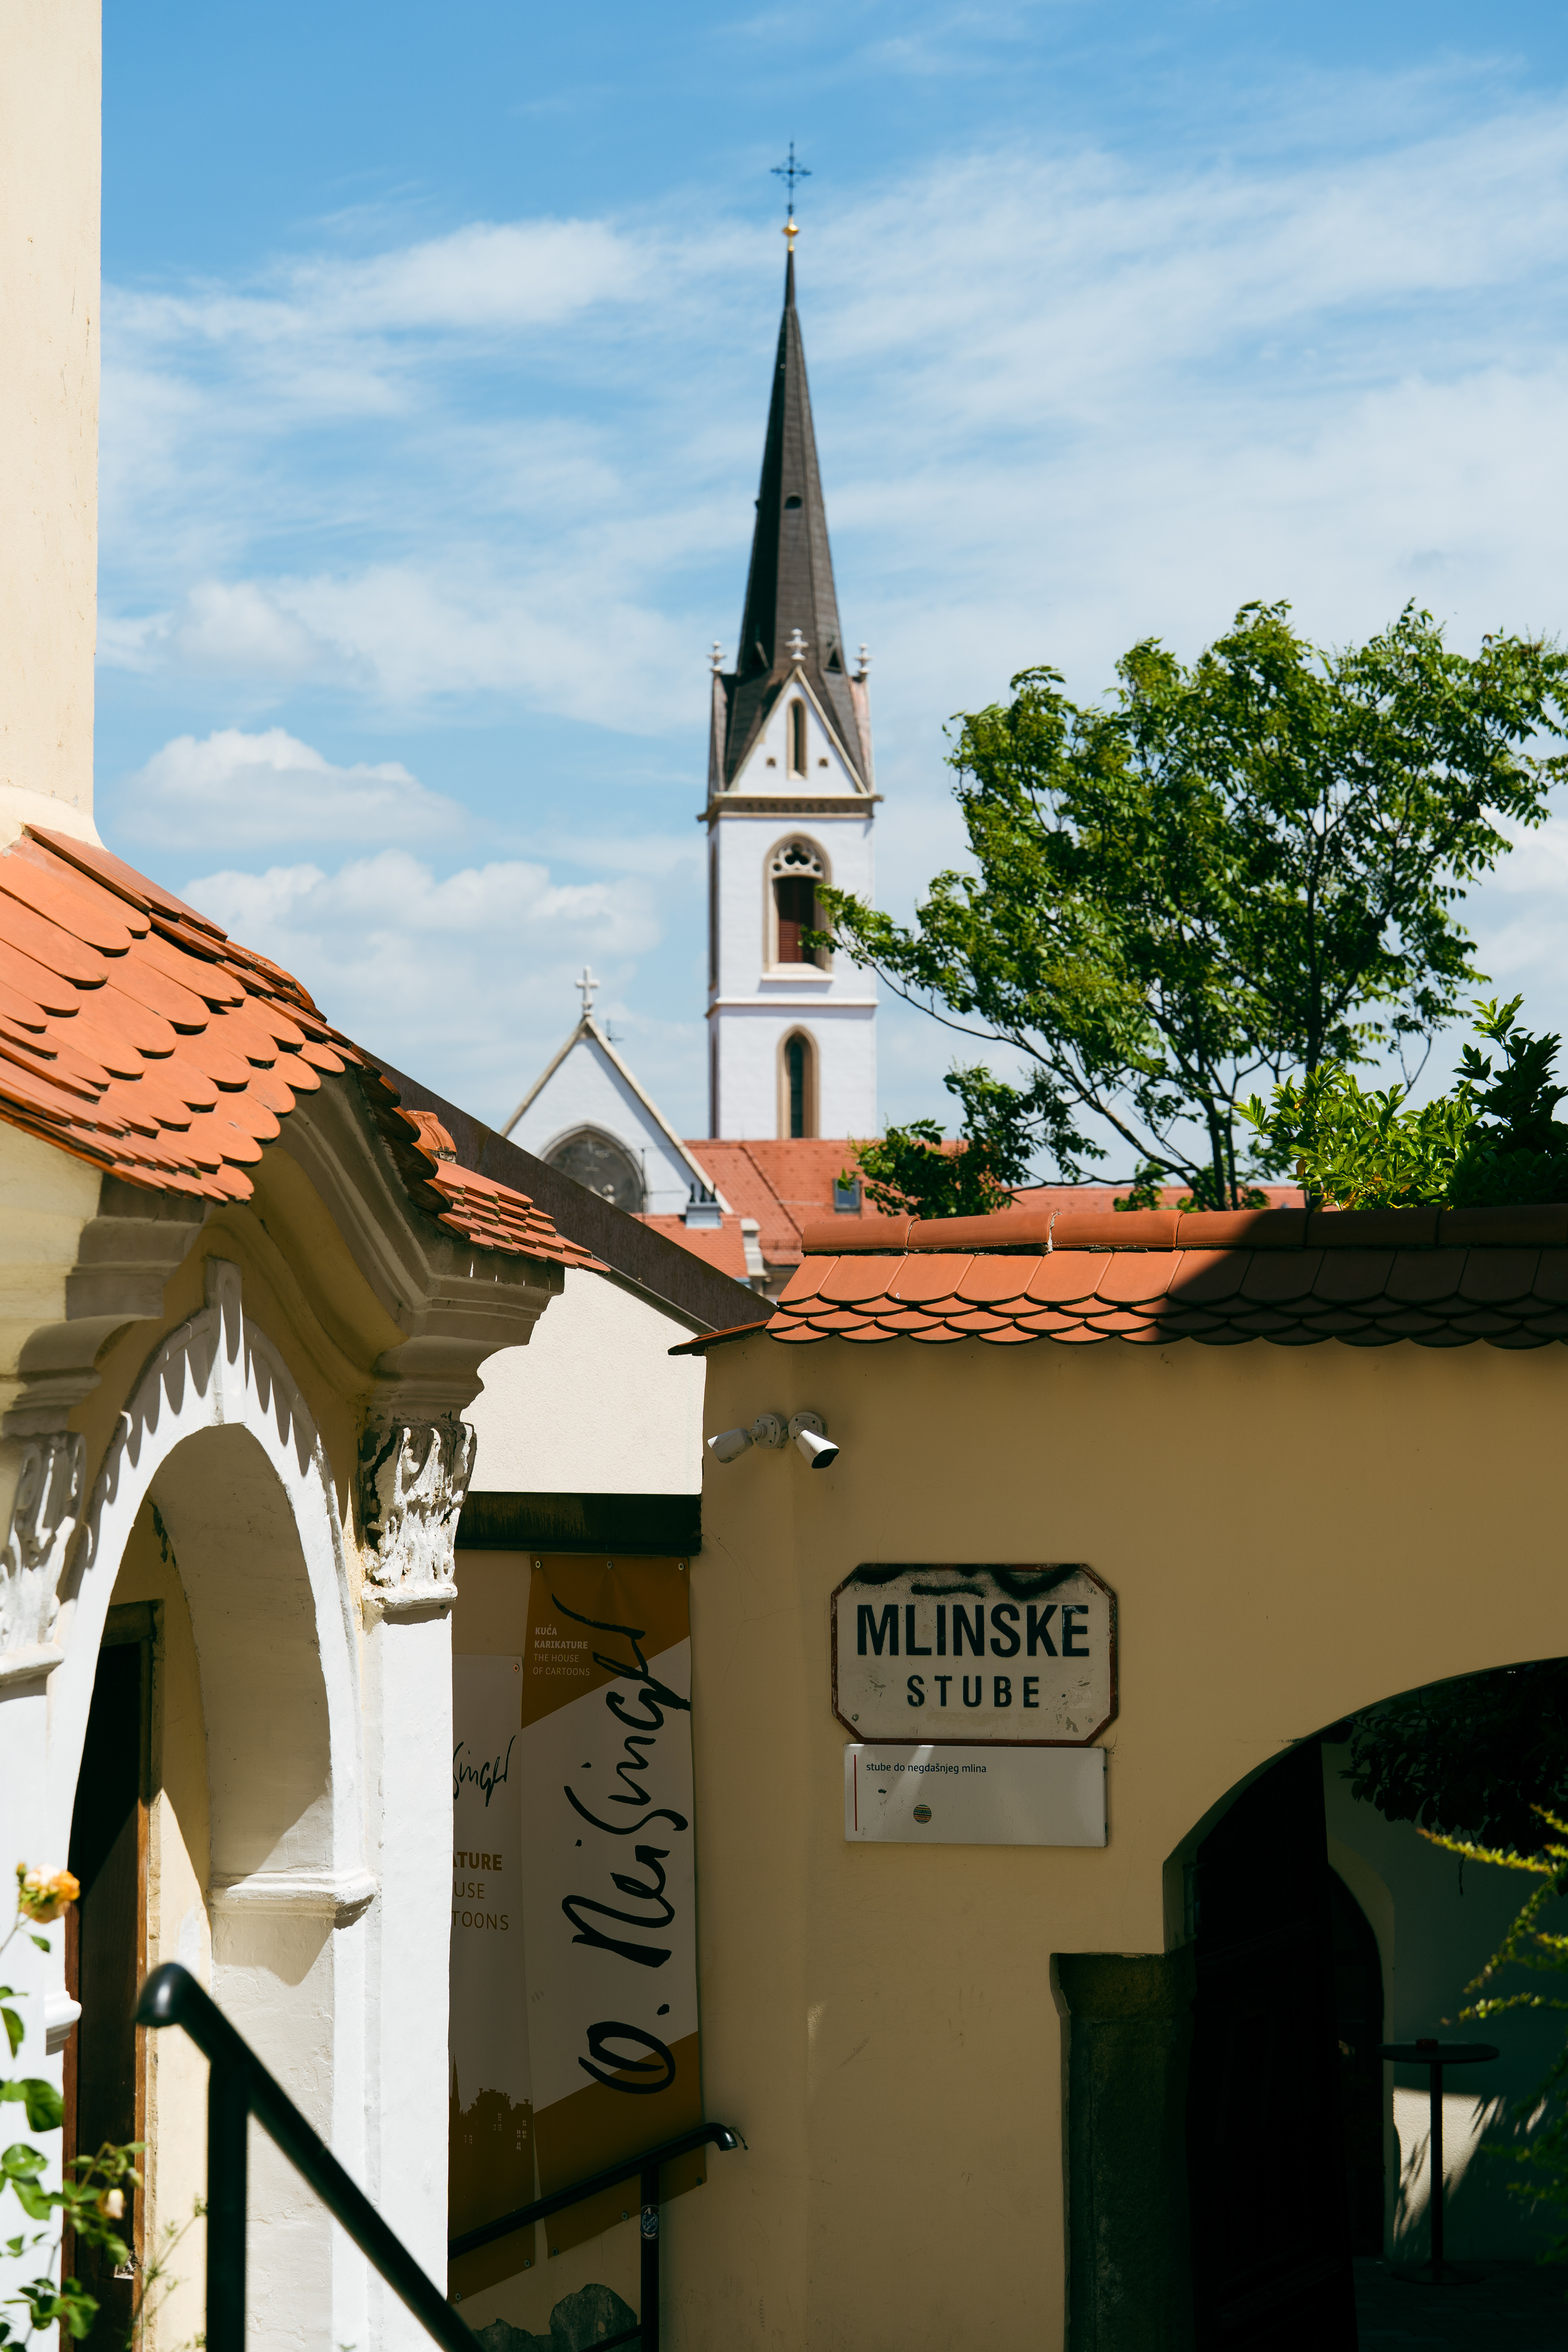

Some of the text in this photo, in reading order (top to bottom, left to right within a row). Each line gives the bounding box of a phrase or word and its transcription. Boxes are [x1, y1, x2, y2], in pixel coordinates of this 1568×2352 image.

[535, 1624, 557, 1635] KUĆA
[857, 1603, 1090, 1658] MLINSKE
[534, 1640, 588, 1649] KARIKATURE
[552, 1654, 579, 1662] HOUSE
[546, 1667, 590, 1676] CARTOONS
[907, 1674, 1039, 1708] STUBE
[866, 1762, 987, 1775] stube do negdašnjeg mlina
